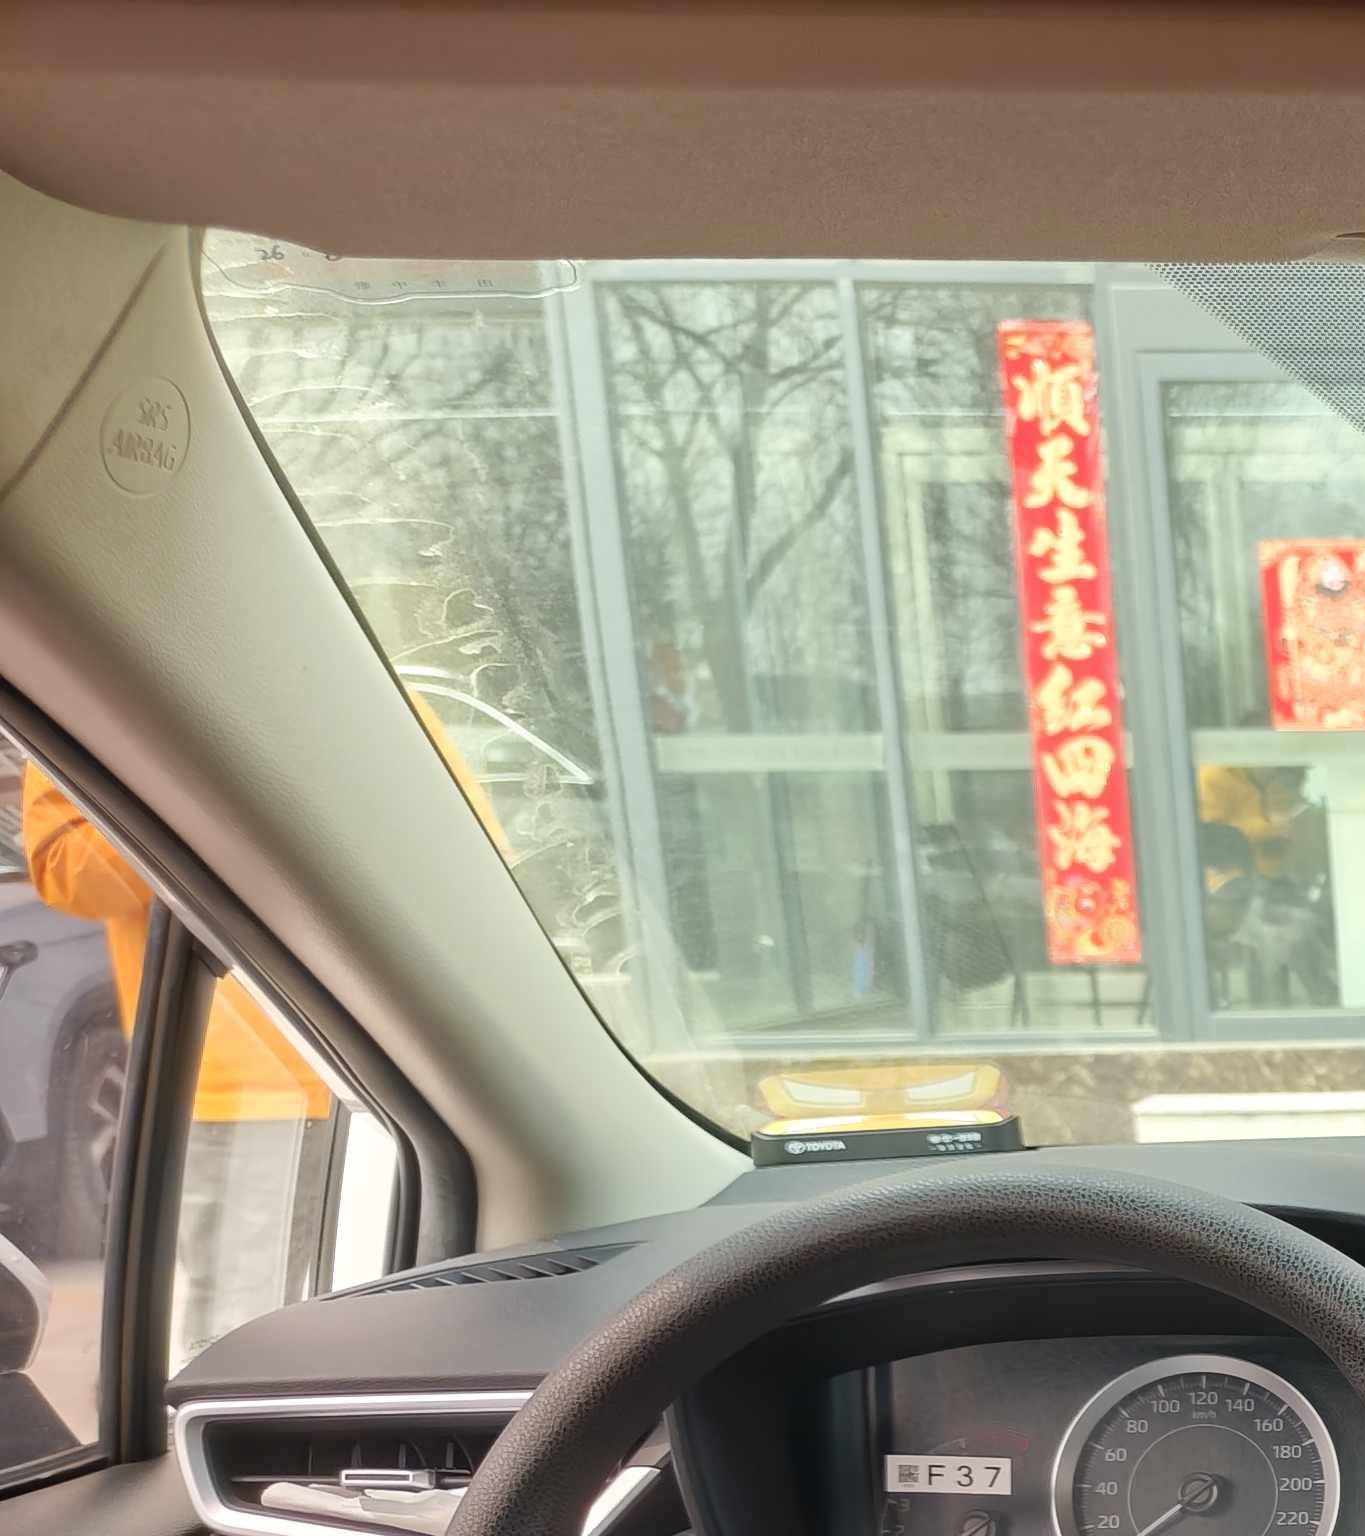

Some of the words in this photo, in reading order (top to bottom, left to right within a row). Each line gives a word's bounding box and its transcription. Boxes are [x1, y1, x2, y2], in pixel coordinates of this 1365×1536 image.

[137, 397, 173, 432] SRS
[108, 429, 177, 472] AIRBAG
[806, 1139, 847, 1151] TOYOTA
[1188, 1391, 1218, 1405] 120
[1151, 1399, 1181, 1413] 100
[1226, 1399, 1255, 1412] 140
[1126, 1419, 1149, 1433] 80
[1254, 1418, 1284, 1432] 160
[1104, 1448, 1128, 1462] 60
[1273, 1445, 1302, 1459] 180
[1095, 1481, 1118, 1496] 40
[1279, 1478, 1313, 1491] 200
[1097, 1515, 1120, 1529] 20
[1276, 1511, 1309, 1526] 220
